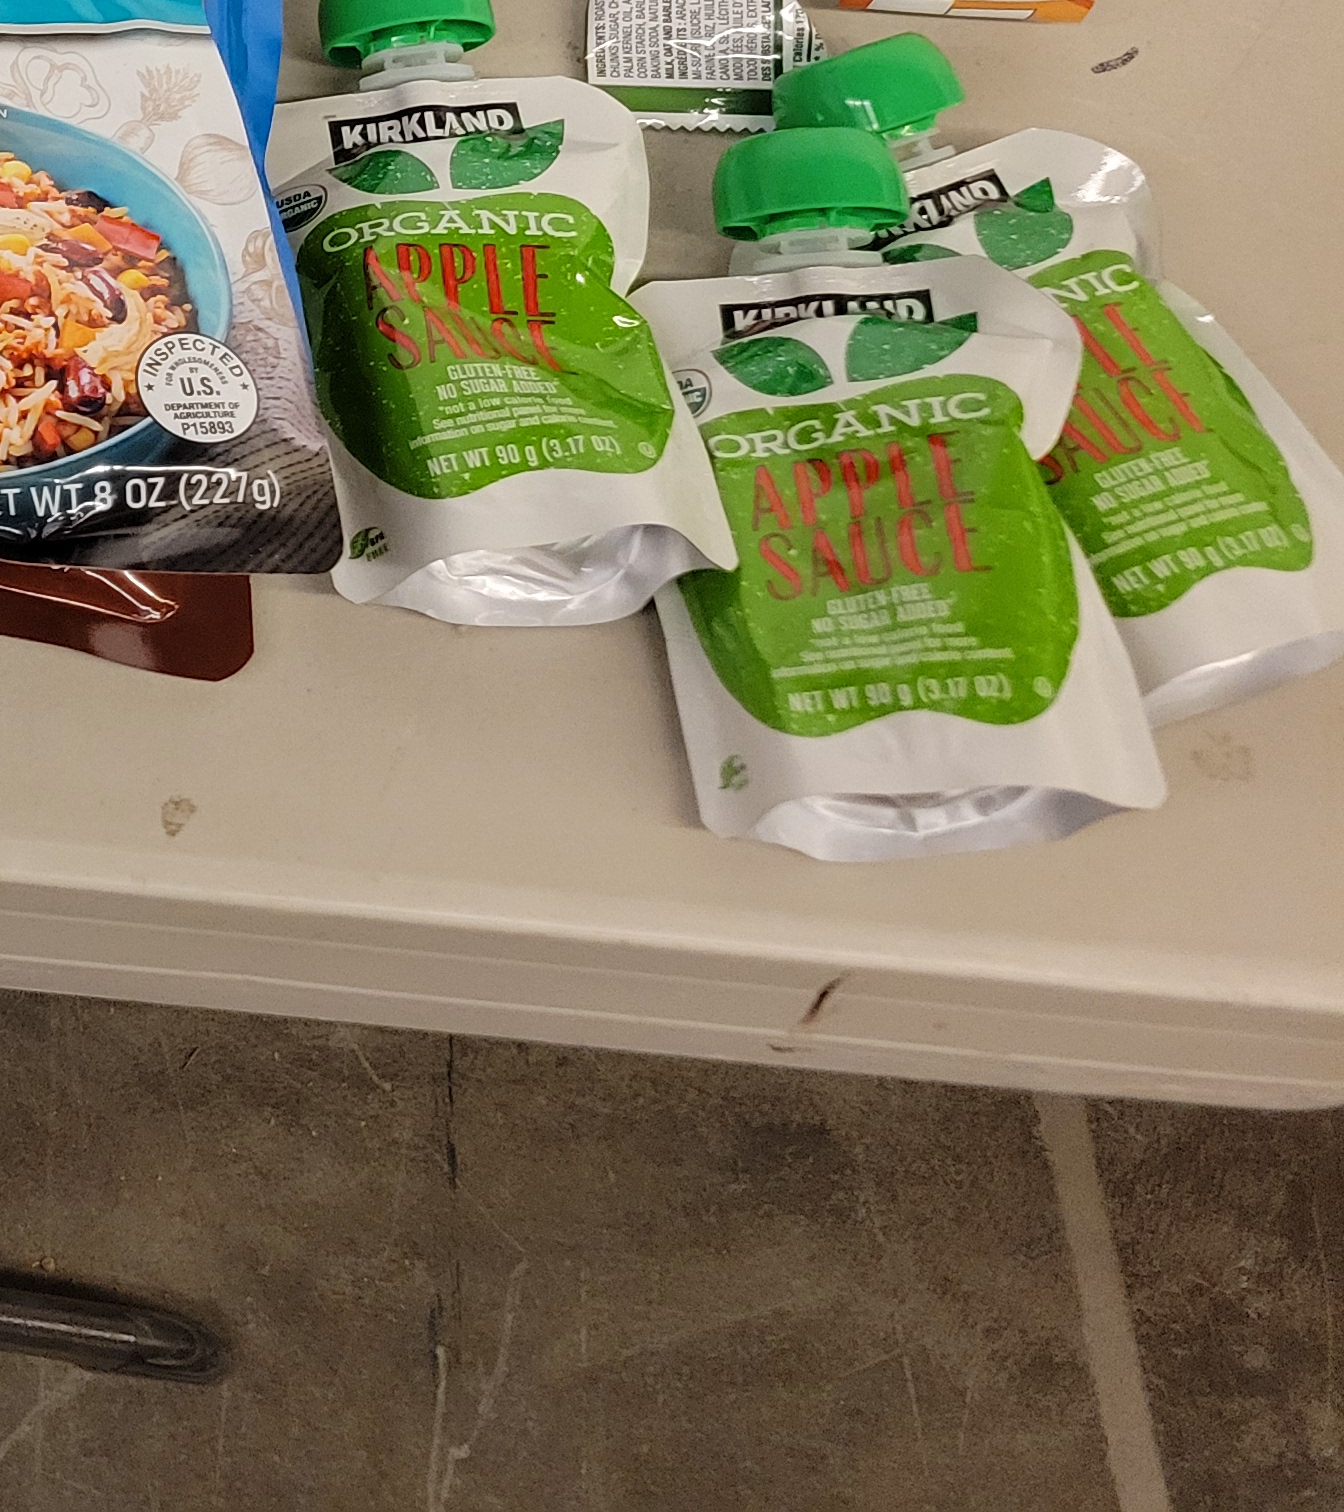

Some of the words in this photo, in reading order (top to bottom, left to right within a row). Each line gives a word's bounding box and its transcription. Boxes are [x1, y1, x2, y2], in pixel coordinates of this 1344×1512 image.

[793, 27, 804, 62] Calories
[637, 57, 647, 78] CORN
[341, 108, 514, 149] KIRKLAND
[275, 190, 312, 208] USDA
[323, 210, 577, 253] ORGANIC
[365, 243, 555, 316] APPLE
[376, 305, 576, 376] SAUCE
[142, 337, 244, 378] INSPECTED
[165, 372, 174, 387] FOR
[172, 356, 229, 385] WHOLESOMENESS
[446, 362, 541, 381] GLUTEN-FREE
[179, 376, 221, 396] U.S.
[436, 384, 458, 401] NO
[463, 379, 508, 395] SUGAR
[479, 397, 500, 408] low
[163, 401, 226, 412] DEPARTMENT
[228, 401, 240, 409] OF
[173, 410, 236, 420] AGRICULTURE
[181, 420, 235, 436] P15893
[433, 417, 455, 430] See
[707, 392, 993, 459] ORGANIC
[427, 453, 458, 477] NET
[463, 447, 491, 468] WT
[495, 444, 520, 464] 90
[525, 445, 539, 466] g
[542, 435, 585, 462] (3.17
[29, 483, 84, 518] WT
[93, 480, 113, 511] 8
[125, 476, 168, 509] OZ
[178, 470, 280, 511] (227g)
[752, 431, 976, 532] APPLE
[758, 502, 994, 601] SAUCE
[1112, 566, 1150, 594] NET
[1148, 554, 1180, 578] WT
[788, 690, 824, 712] NET
[828, 687, 859, 709] WT
[865, 682, 892, 706] 90
[896, 683, 911, 706] g
